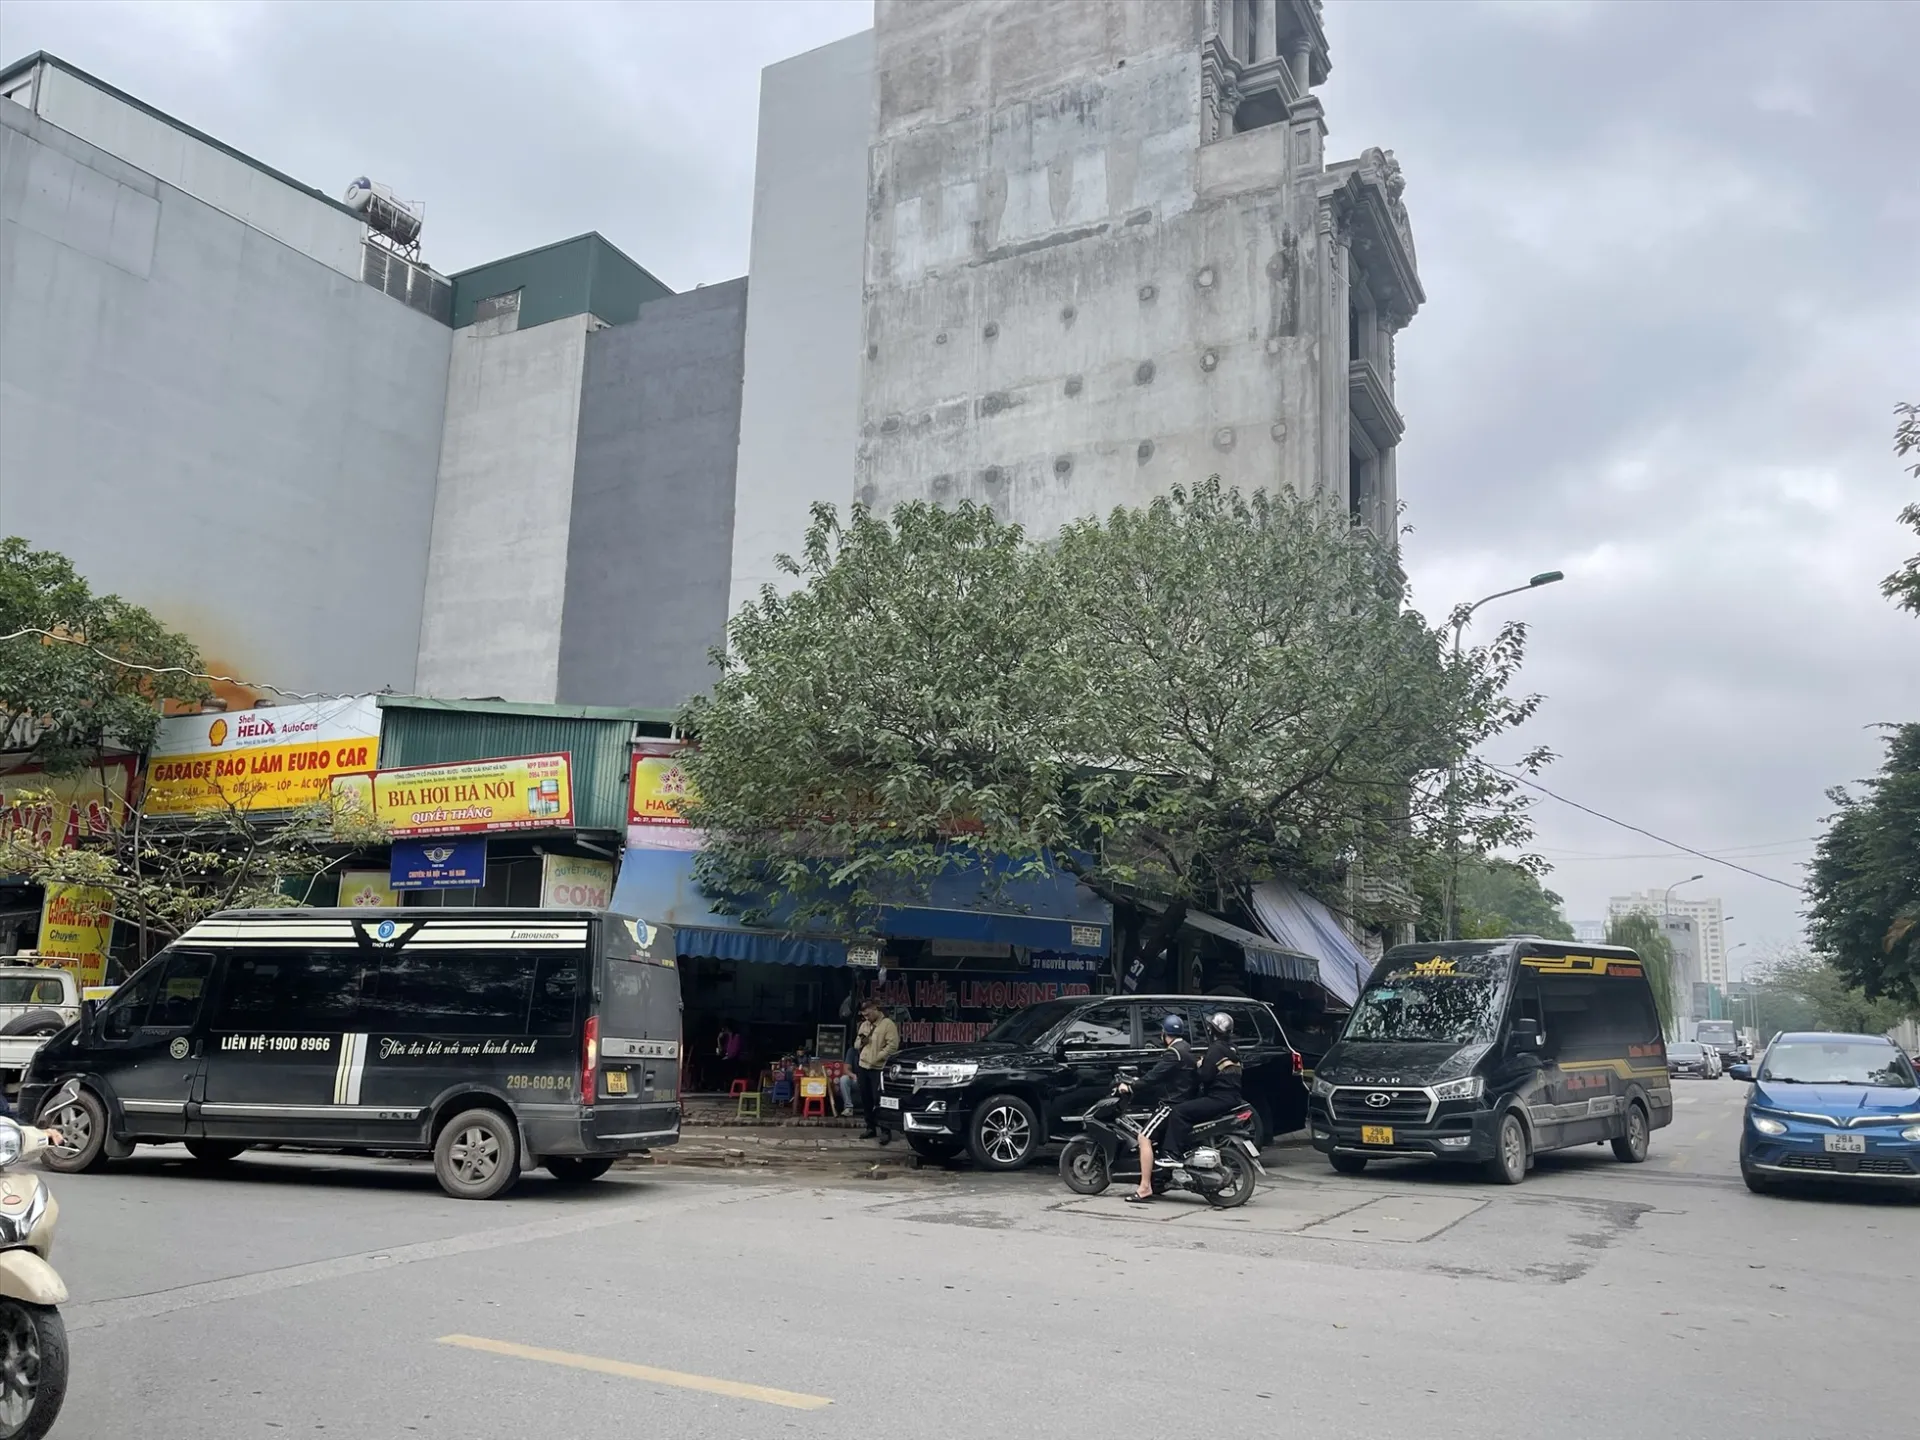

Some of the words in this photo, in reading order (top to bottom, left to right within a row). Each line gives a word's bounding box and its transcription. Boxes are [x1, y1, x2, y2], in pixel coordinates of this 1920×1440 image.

[238, 714, 256, 724] Shell
[238, 719, 276, 738] HELIX
[281, 722, 318, 734] AutoCare
[154, 760, 213, 781] GARAGE
[287, 750, 331, 771] EURO
[336, 747, 368, 768] CAR
[388, 789, 417, 807] BIA
[454, 781, 481, 801] HÀ
[484, 778, 516, 801] NỘI
[553, 884, 606, 908] CƠM
[510, 930, 560, 939] Limousines
[1130, 959, 1145, 977] 37
[934, 1021, 976, 1043] NHANH
[221, 1034, 247, 1050] LIÊN
[300, 1037, 331, 1051] 8966
[408, 1041, 425, 1057] đại
[461, 1043, 480, 1057] mọi
[482, 1039, 509, 1054] hành
[510, 1039, 538, 1054] trình
[506, 1075, 572, 1090] 29B-609.84
[1354, 1076, 1401, 1084] DCAR
